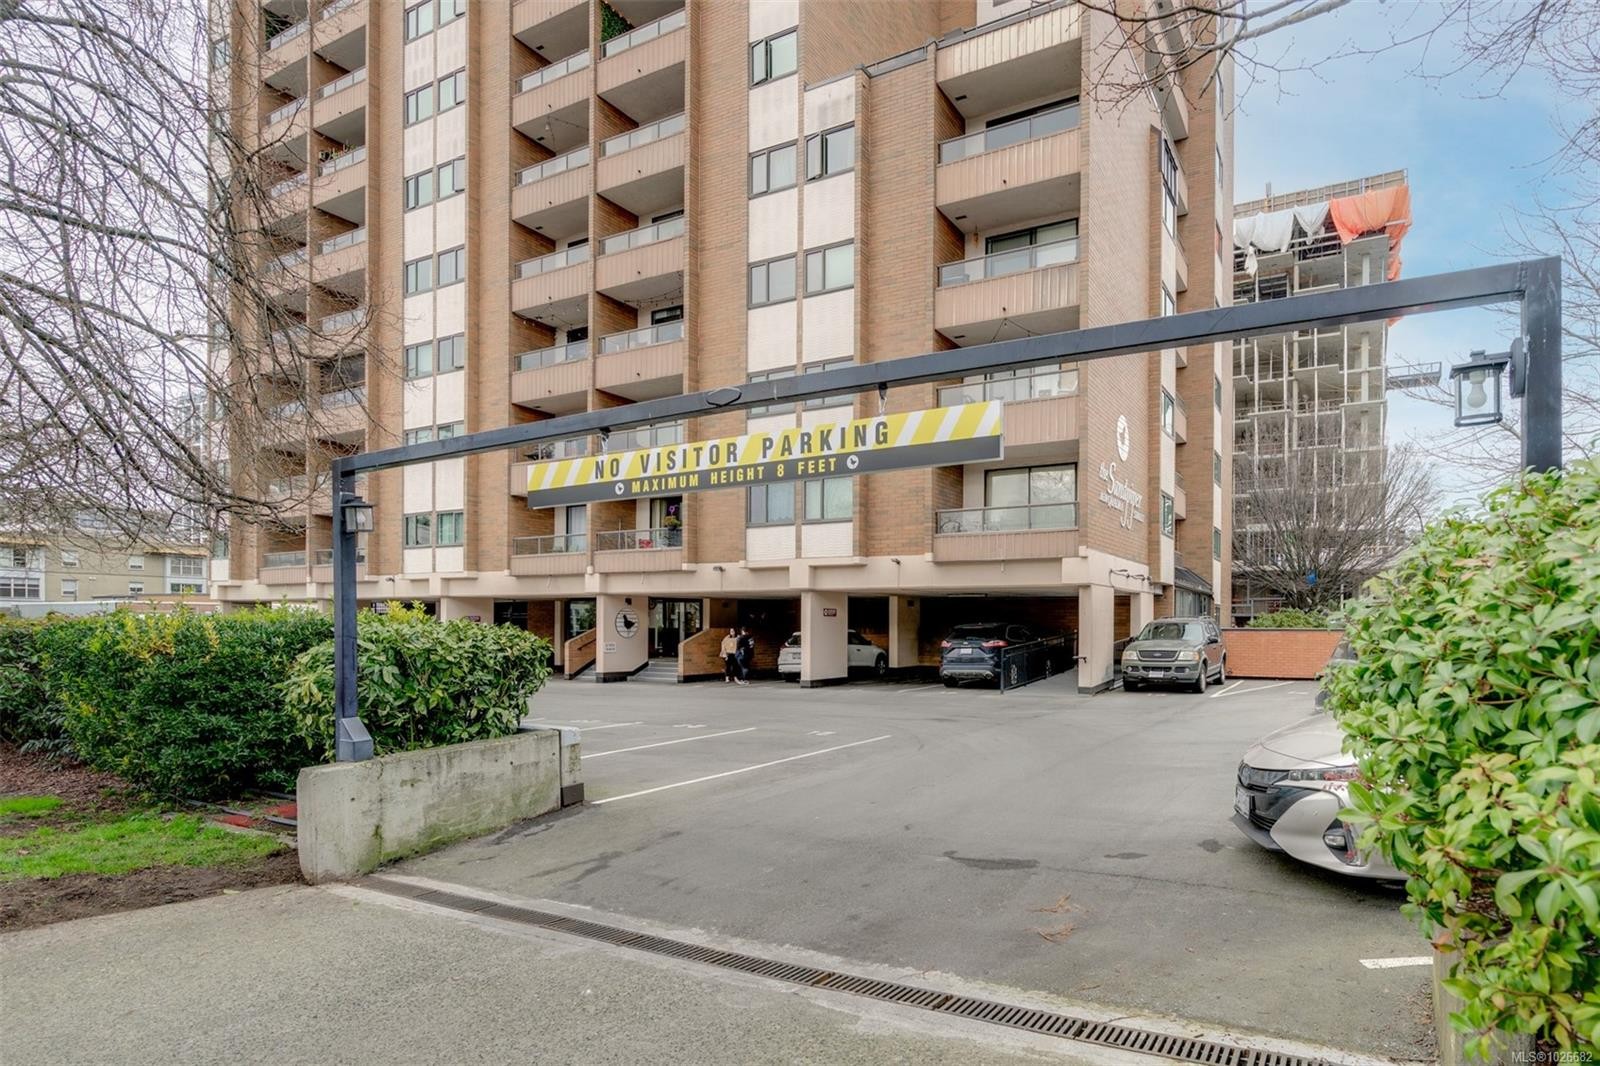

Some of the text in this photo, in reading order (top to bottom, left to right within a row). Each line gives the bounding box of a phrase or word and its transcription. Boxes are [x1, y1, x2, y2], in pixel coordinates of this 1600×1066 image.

[595, 421, 888, 479] NO VISITOR PARKING
[632, 457, 837, 493] MAXIMUM HEIGHT 8 FEET
